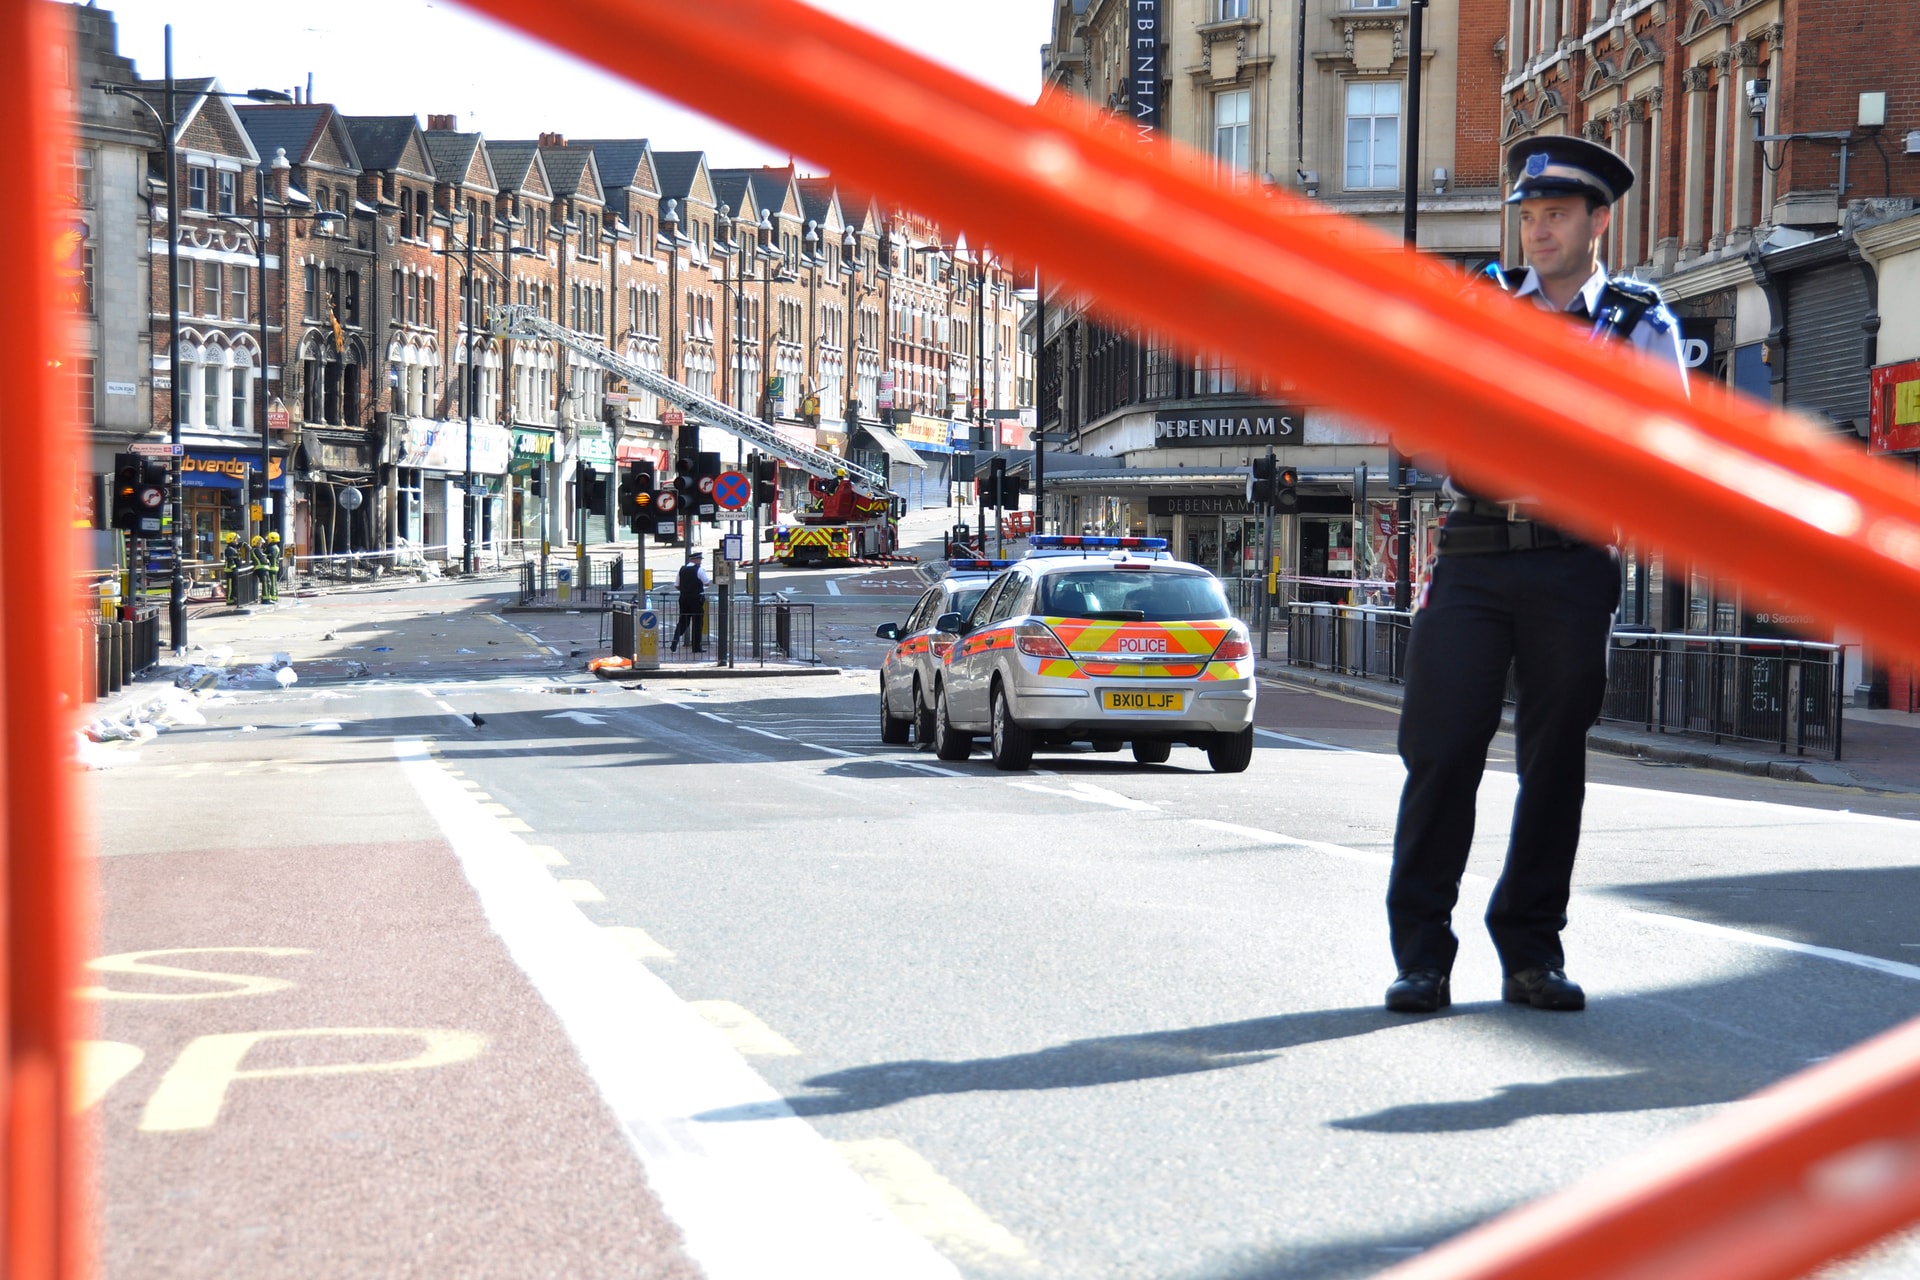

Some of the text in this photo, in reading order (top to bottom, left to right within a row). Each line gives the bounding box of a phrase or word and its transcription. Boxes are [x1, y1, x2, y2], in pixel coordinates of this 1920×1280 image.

[1155, 416, 1293, 438] DEBENHAMS
[519, 432, 554, 454] SUBWAY
[1168, 499, 1255, 511] DEBENHAM
[1756, 613, 1814, 624] 90 Seconds
[1119, 639, 1166, 652] POLICE
[1113, 693, 1175, 708] BX10 LJF
